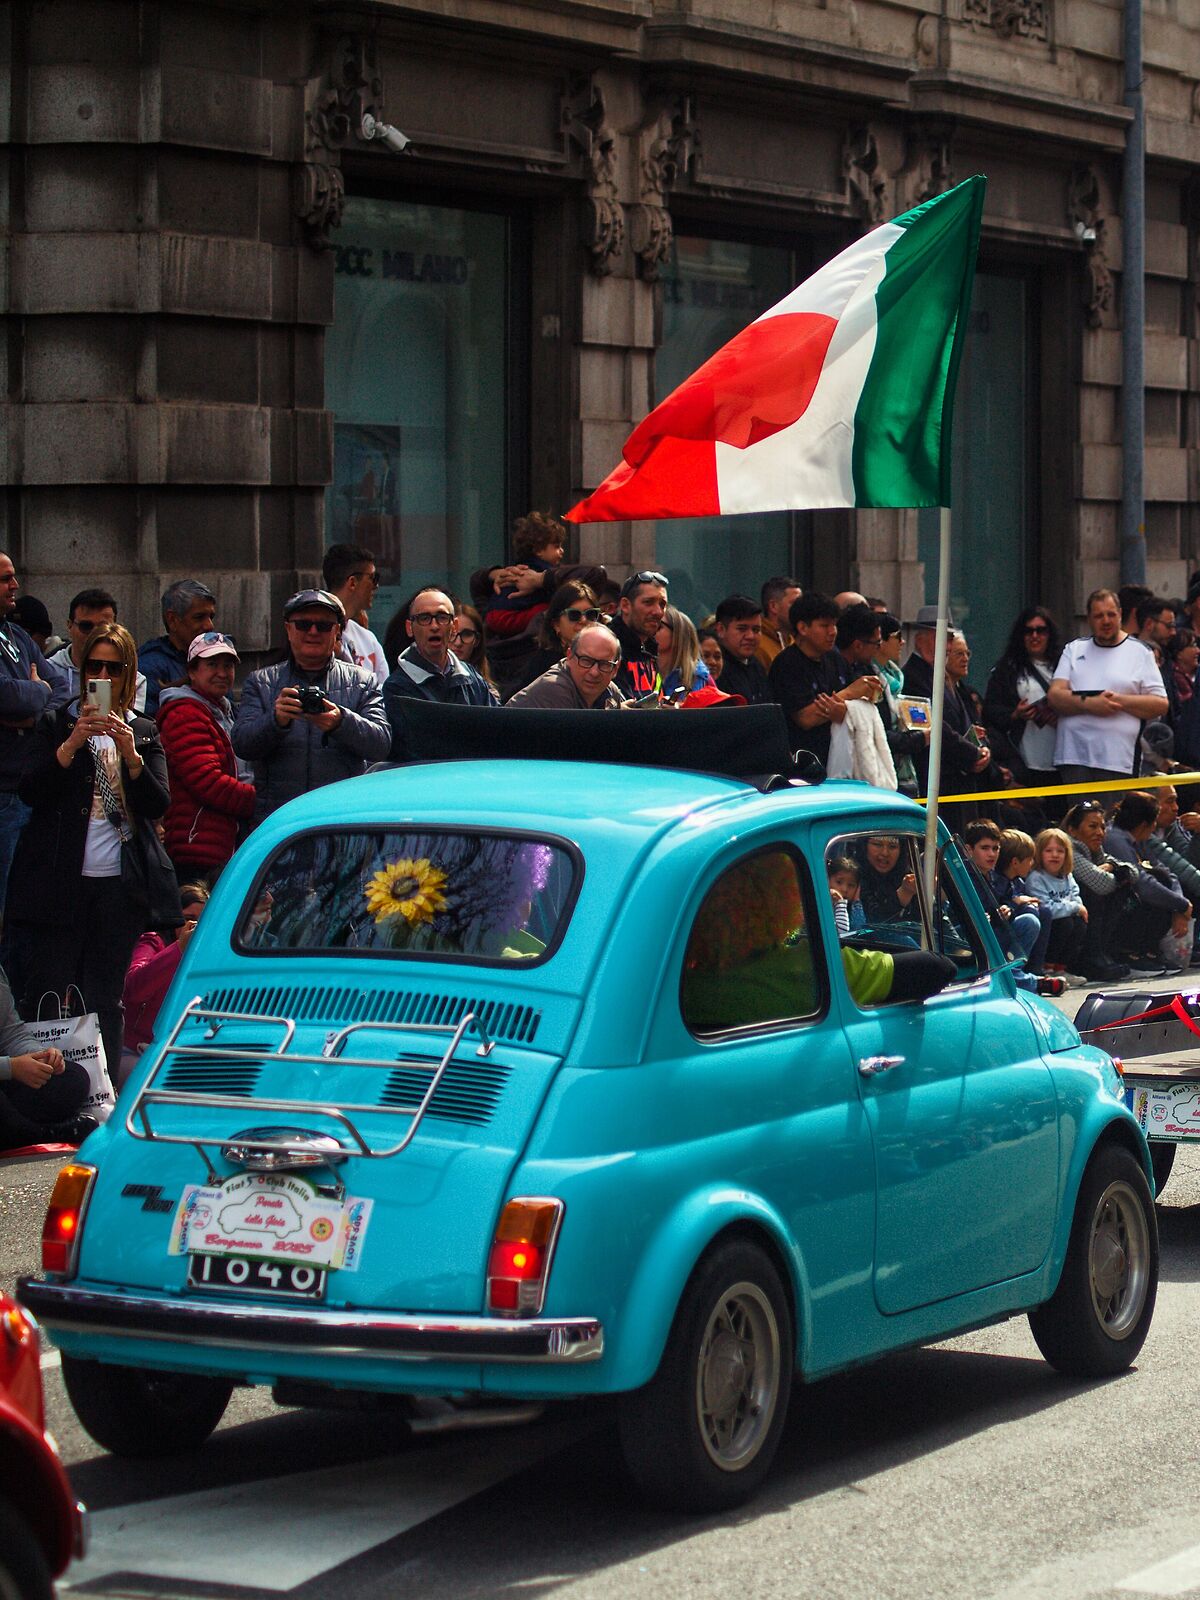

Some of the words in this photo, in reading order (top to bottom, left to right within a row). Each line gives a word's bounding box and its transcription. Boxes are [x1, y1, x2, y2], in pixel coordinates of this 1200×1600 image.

[50, 1027, 69, 1037] tiger
[62, 1047, 87, 1059] flying
[95, 1092, 110, 1102] tiger
[1172, 1087, 1188, 1097] Fiat
[225, 1180, 245, 1194] Fiat
[266, 1175, 285, 1188] Club
[287, 1181, 310, 1201] Italia
[254, 1195, 283, 1209] Parata
[244, 1214, 263, 1225] della
[265, 1215, 285, 1228] Gioia
[205, 1234, 263, 1249] Bergamo
[272, 1241, 315, 1254] 2025
[346, 1236, 358, 1260] LOVE
[202, 1256, 315, 1290] 1040
